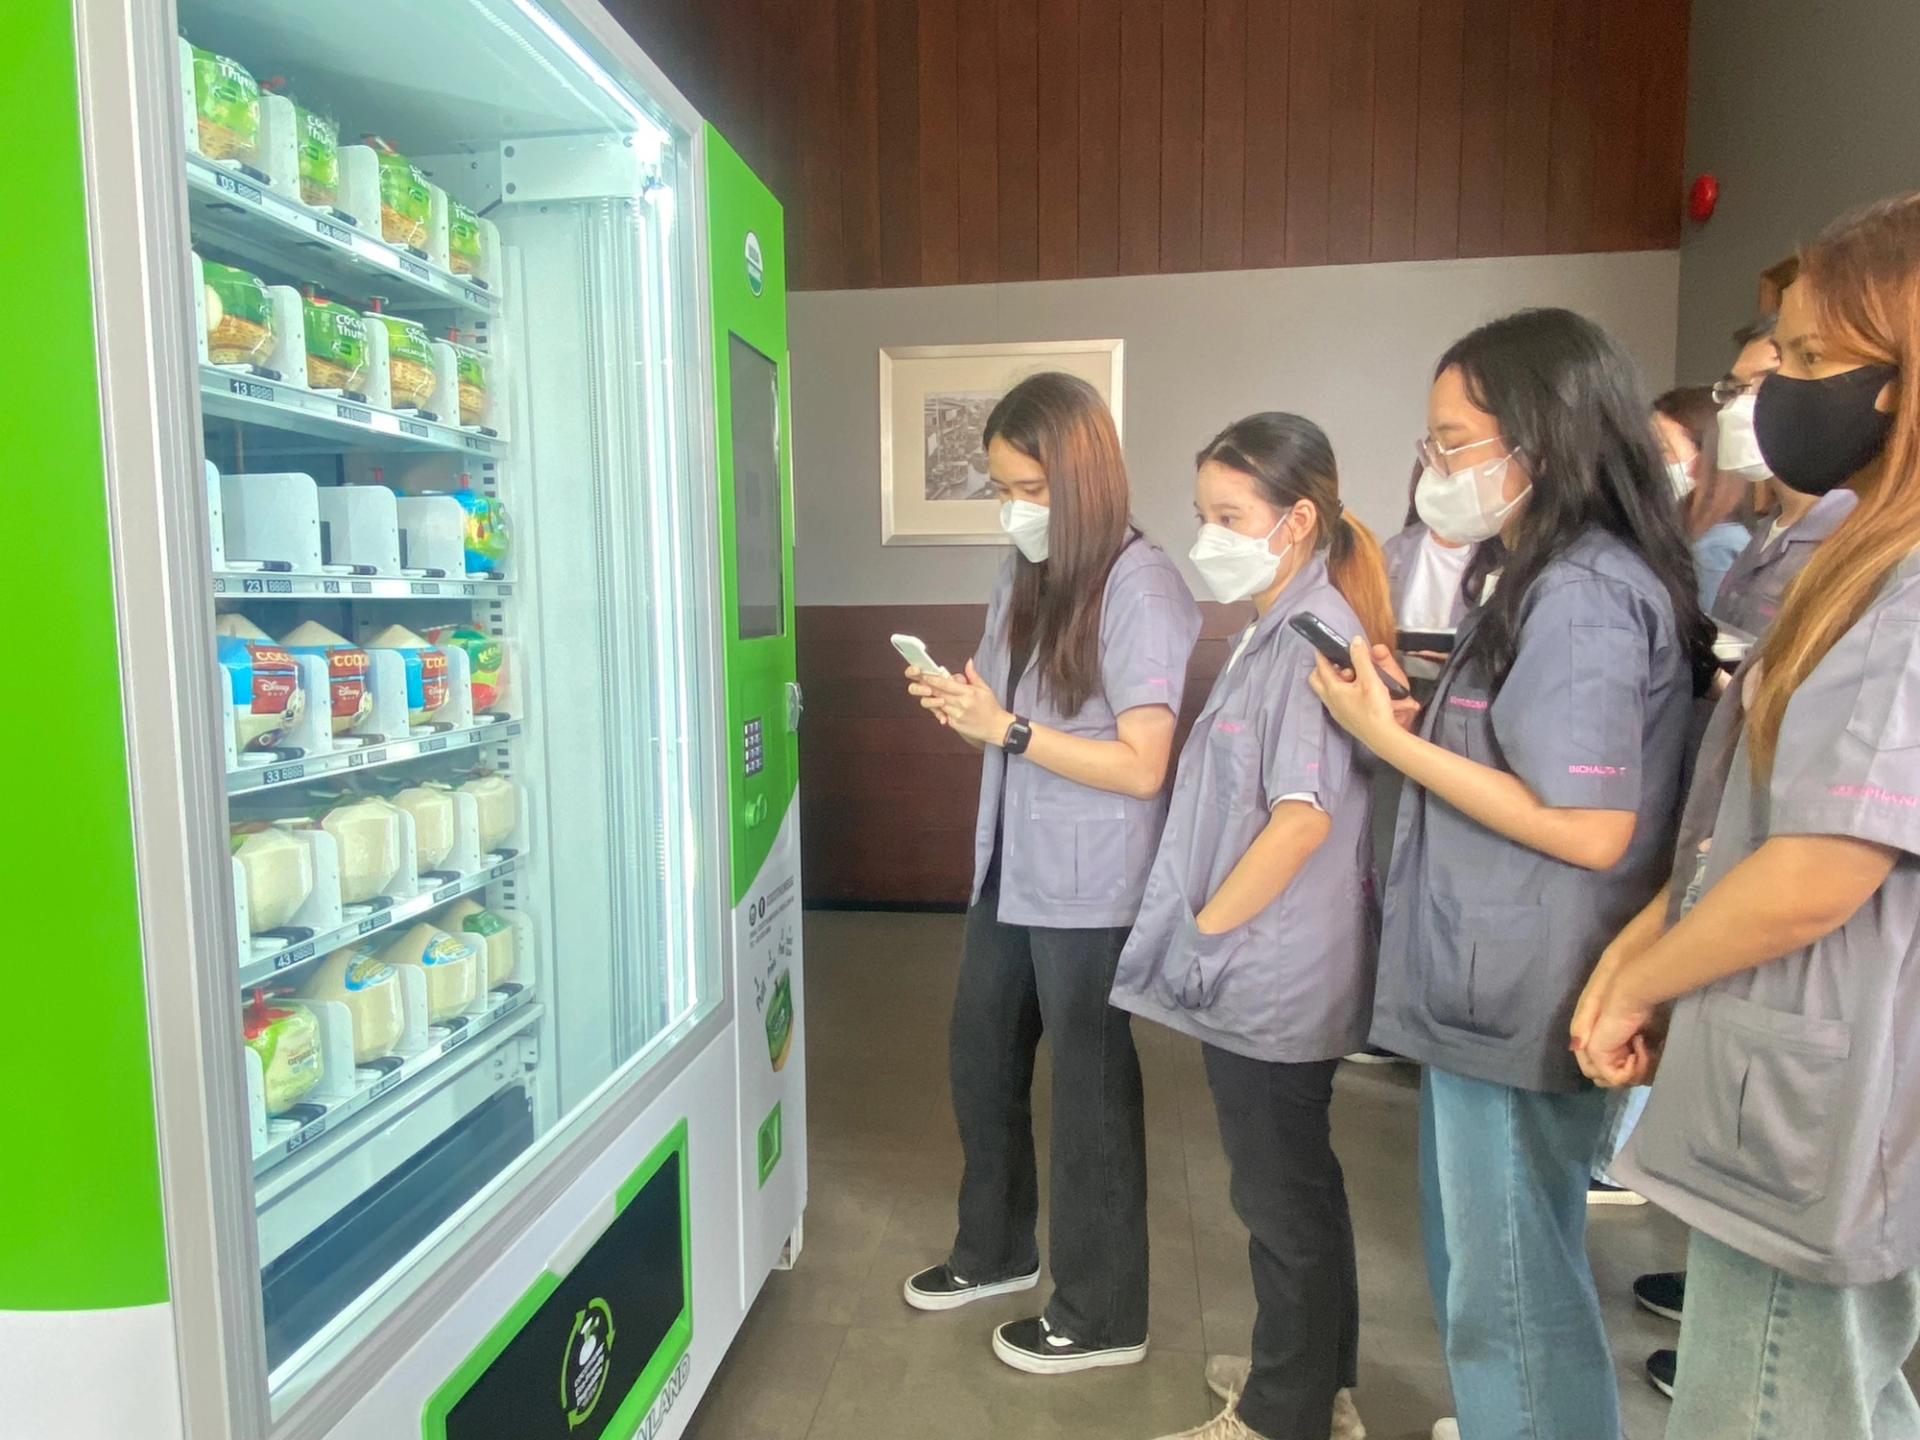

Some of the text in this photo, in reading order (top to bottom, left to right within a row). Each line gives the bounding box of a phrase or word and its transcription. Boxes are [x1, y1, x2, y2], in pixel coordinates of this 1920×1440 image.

[218, 175, 234, 192] 03
[233, 381, 248, 396] 13
[247, 580, 261, 593] 23
[326, 581, 338, 593] 24
[267, 770, 280, 783] 33
[277, 954, 291, 967] 43
